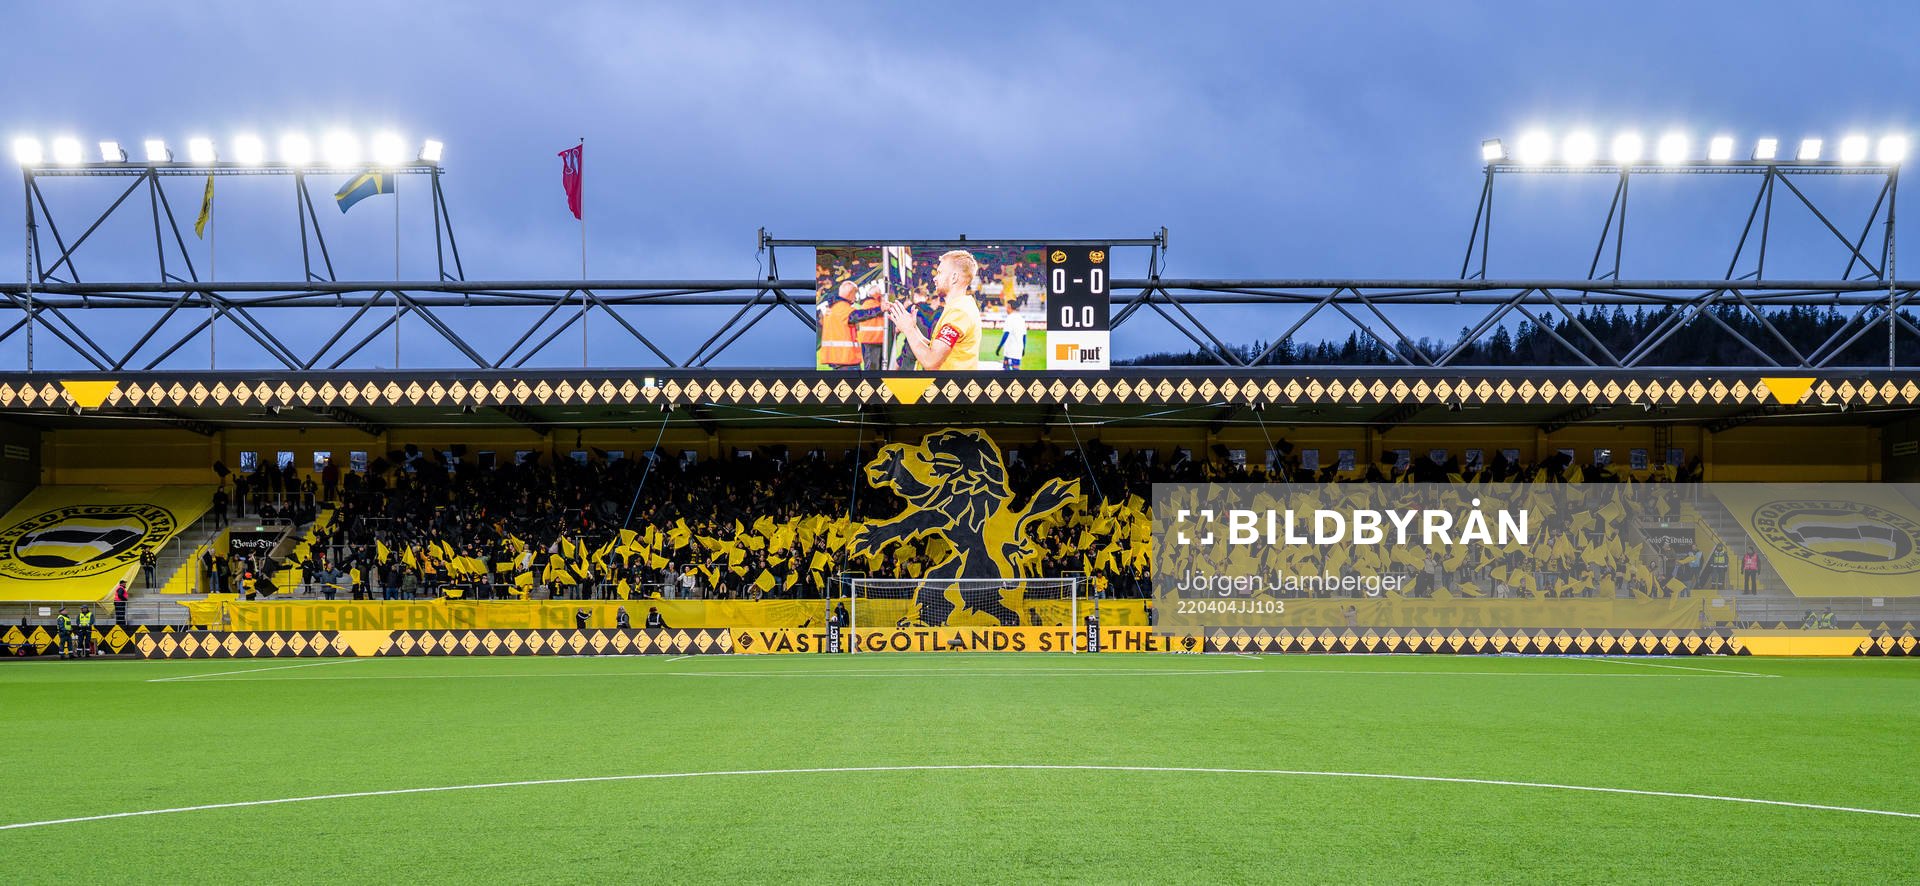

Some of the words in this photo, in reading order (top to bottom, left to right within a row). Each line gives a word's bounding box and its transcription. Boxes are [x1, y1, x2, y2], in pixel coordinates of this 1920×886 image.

[1053, 268, 1065, 294] 0
[1091, 268, 1103, 294] 0
[1061, 306, 1094, 328] 0.0
[830, 625, 839, 653] SELECT
[1039, 629, 1176, 652] STOTHET
[1088, 624, 1097, 652] SELECT
